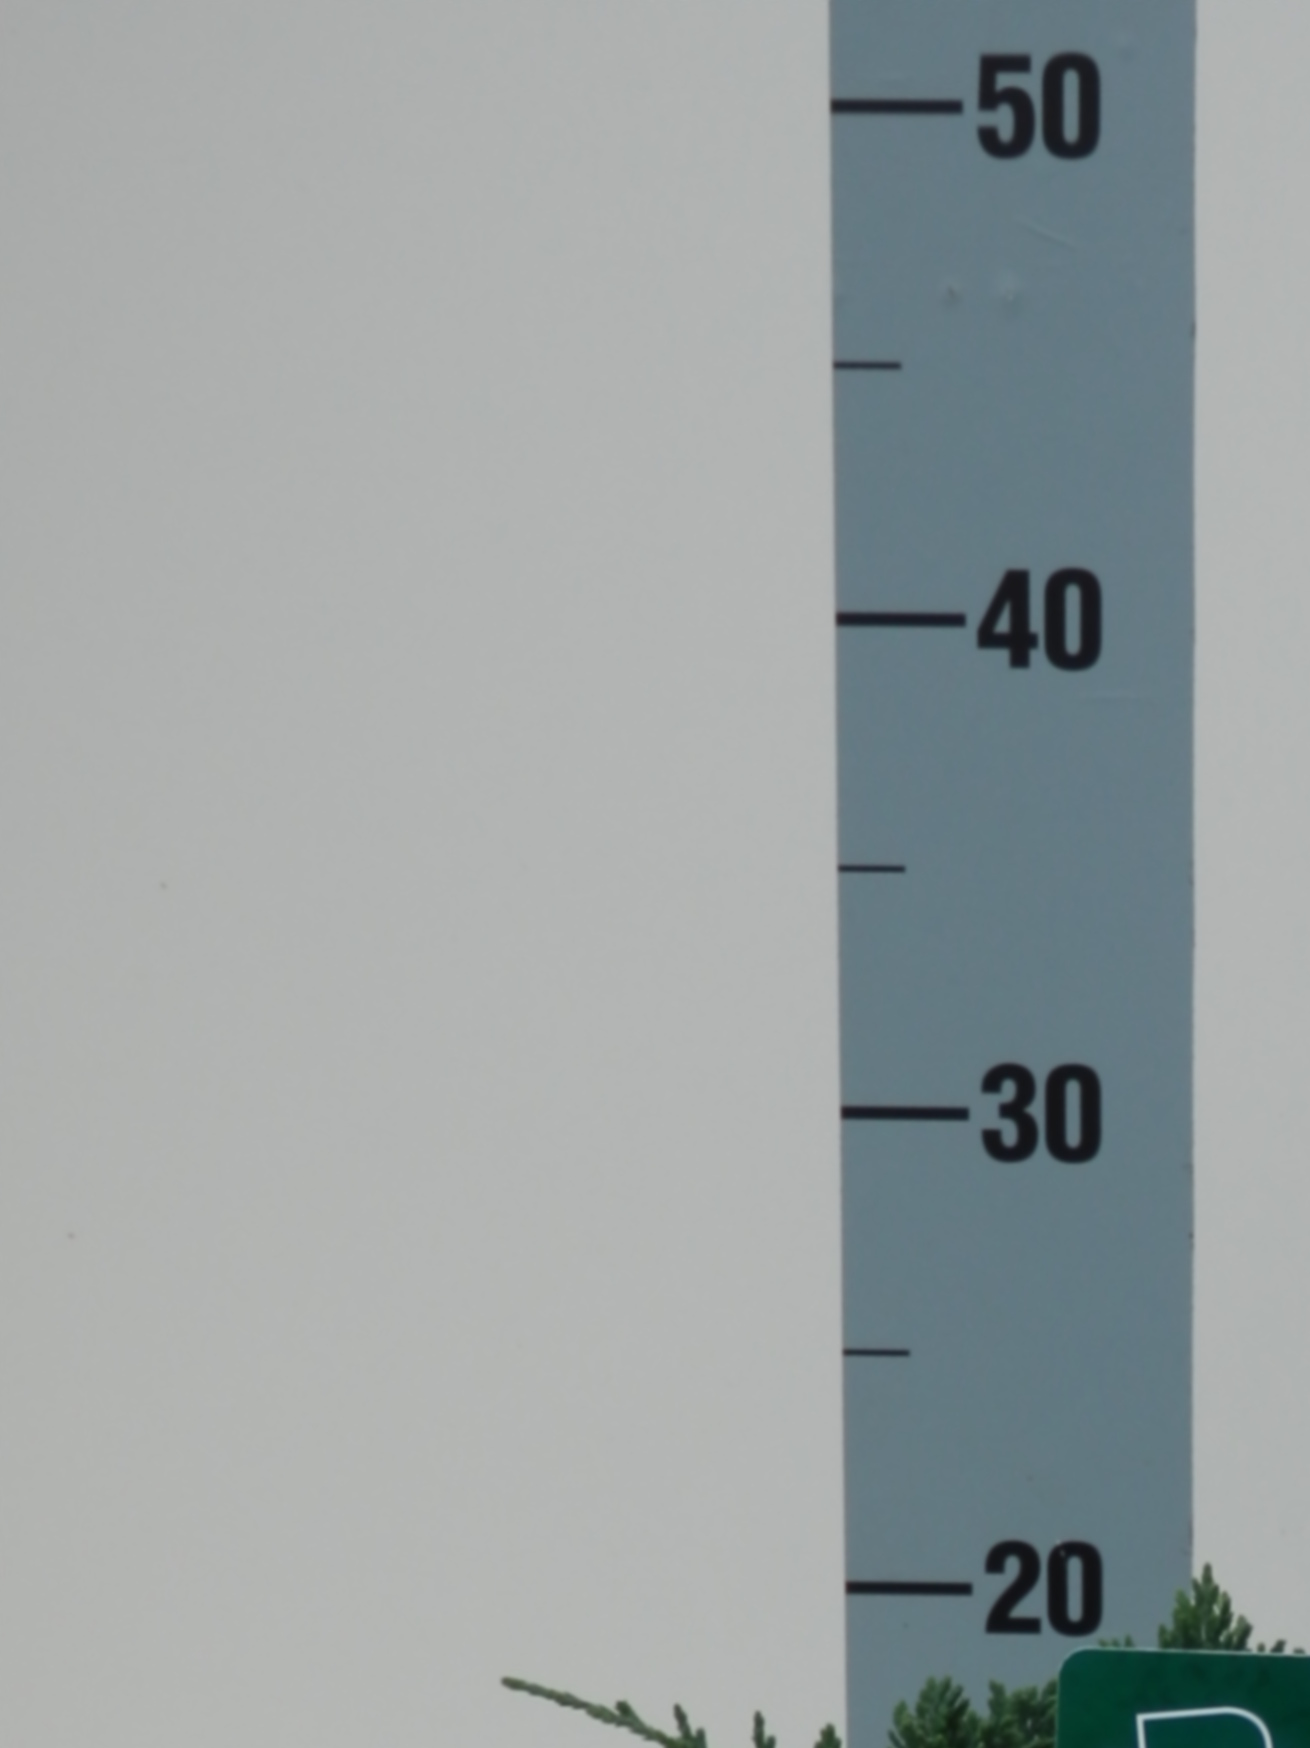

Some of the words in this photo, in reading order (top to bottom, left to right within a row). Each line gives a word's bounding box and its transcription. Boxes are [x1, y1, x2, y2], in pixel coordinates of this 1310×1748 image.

[977, 52, 1101, 160] 50
[976, 567, 1103, 672] 40
[980, 1062, 1102, 1164] 30
[984, 1539, 1104, 1638] 20
